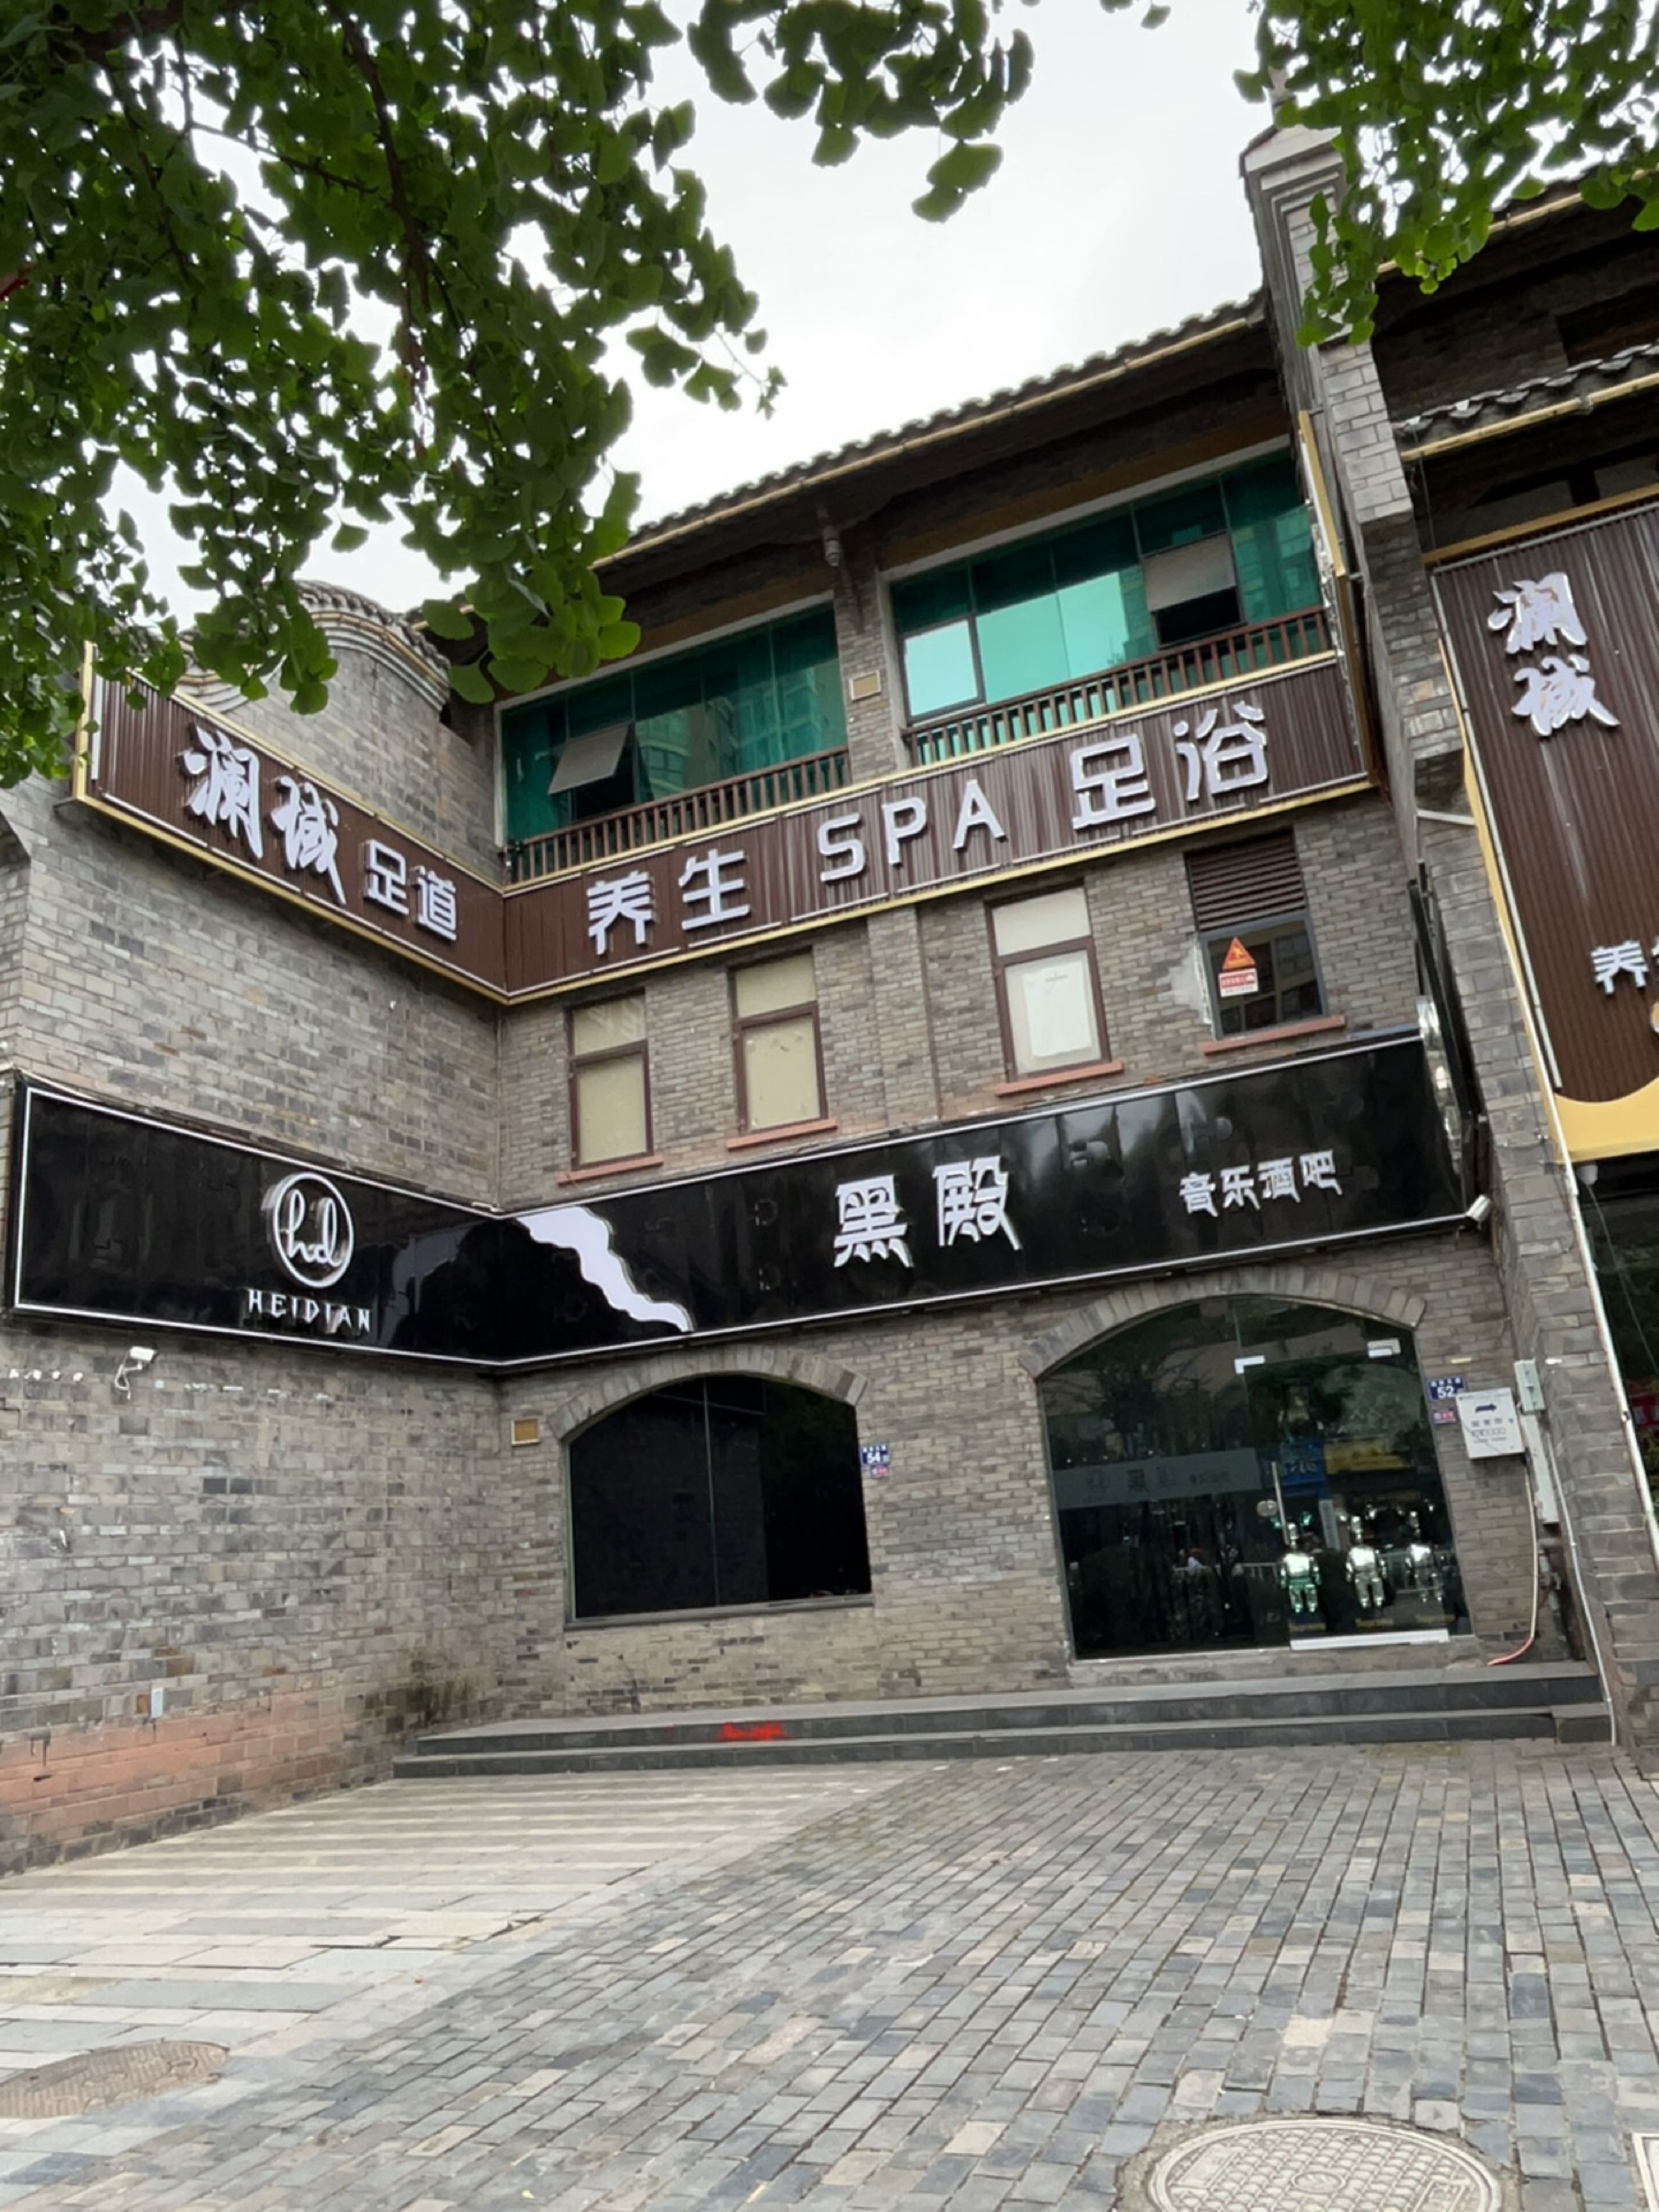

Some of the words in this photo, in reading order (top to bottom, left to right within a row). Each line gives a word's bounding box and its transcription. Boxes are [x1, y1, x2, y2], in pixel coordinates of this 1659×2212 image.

[587, 847, 751, 956] 养生
[819, 779, 1006, 881] SPA
[1070, 701, 1269, 830] 足浴
[364, 839, 456, 941] 足道
[1591, 936, 1659, 994] 养
[833, 1155, 1022, 1268] 黑殿
[1179, 1150, 1343, 1217] 音乐酒吧
[248, 1288, 371, 1333] HEIDIAN
[1438, 1385, 1454, 1399] 52
